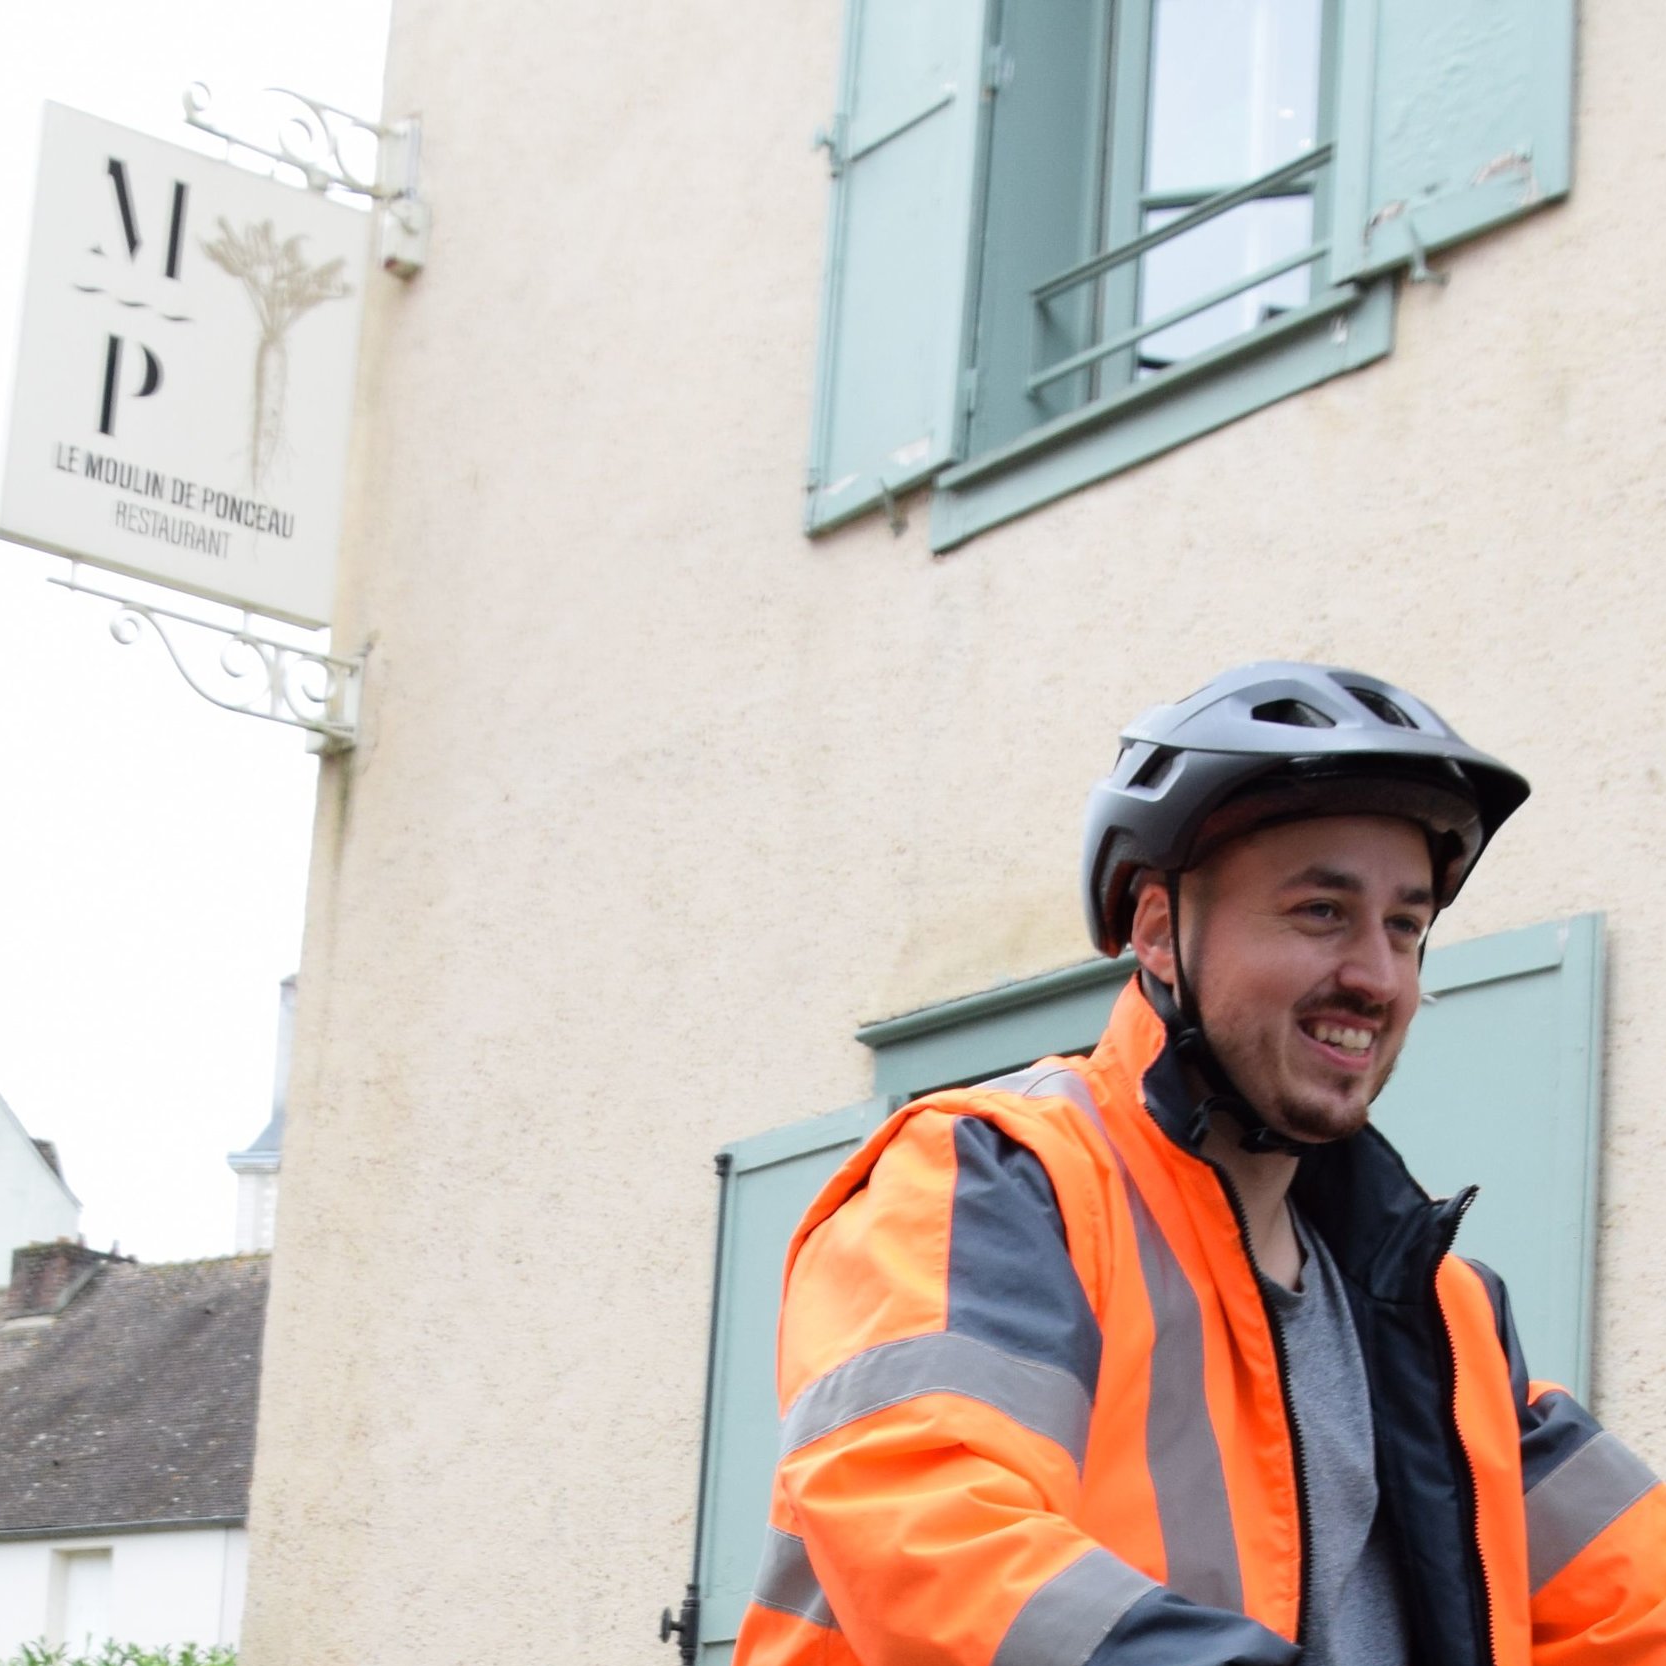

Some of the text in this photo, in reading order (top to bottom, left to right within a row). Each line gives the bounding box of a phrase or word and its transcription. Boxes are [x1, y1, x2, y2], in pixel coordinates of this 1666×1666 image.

[98, 332, 164, 437] P
[55, 441, 295, 539] LE MOULIN DE PONCEAU
[115, 499, 233, 559] RESTAURANT
